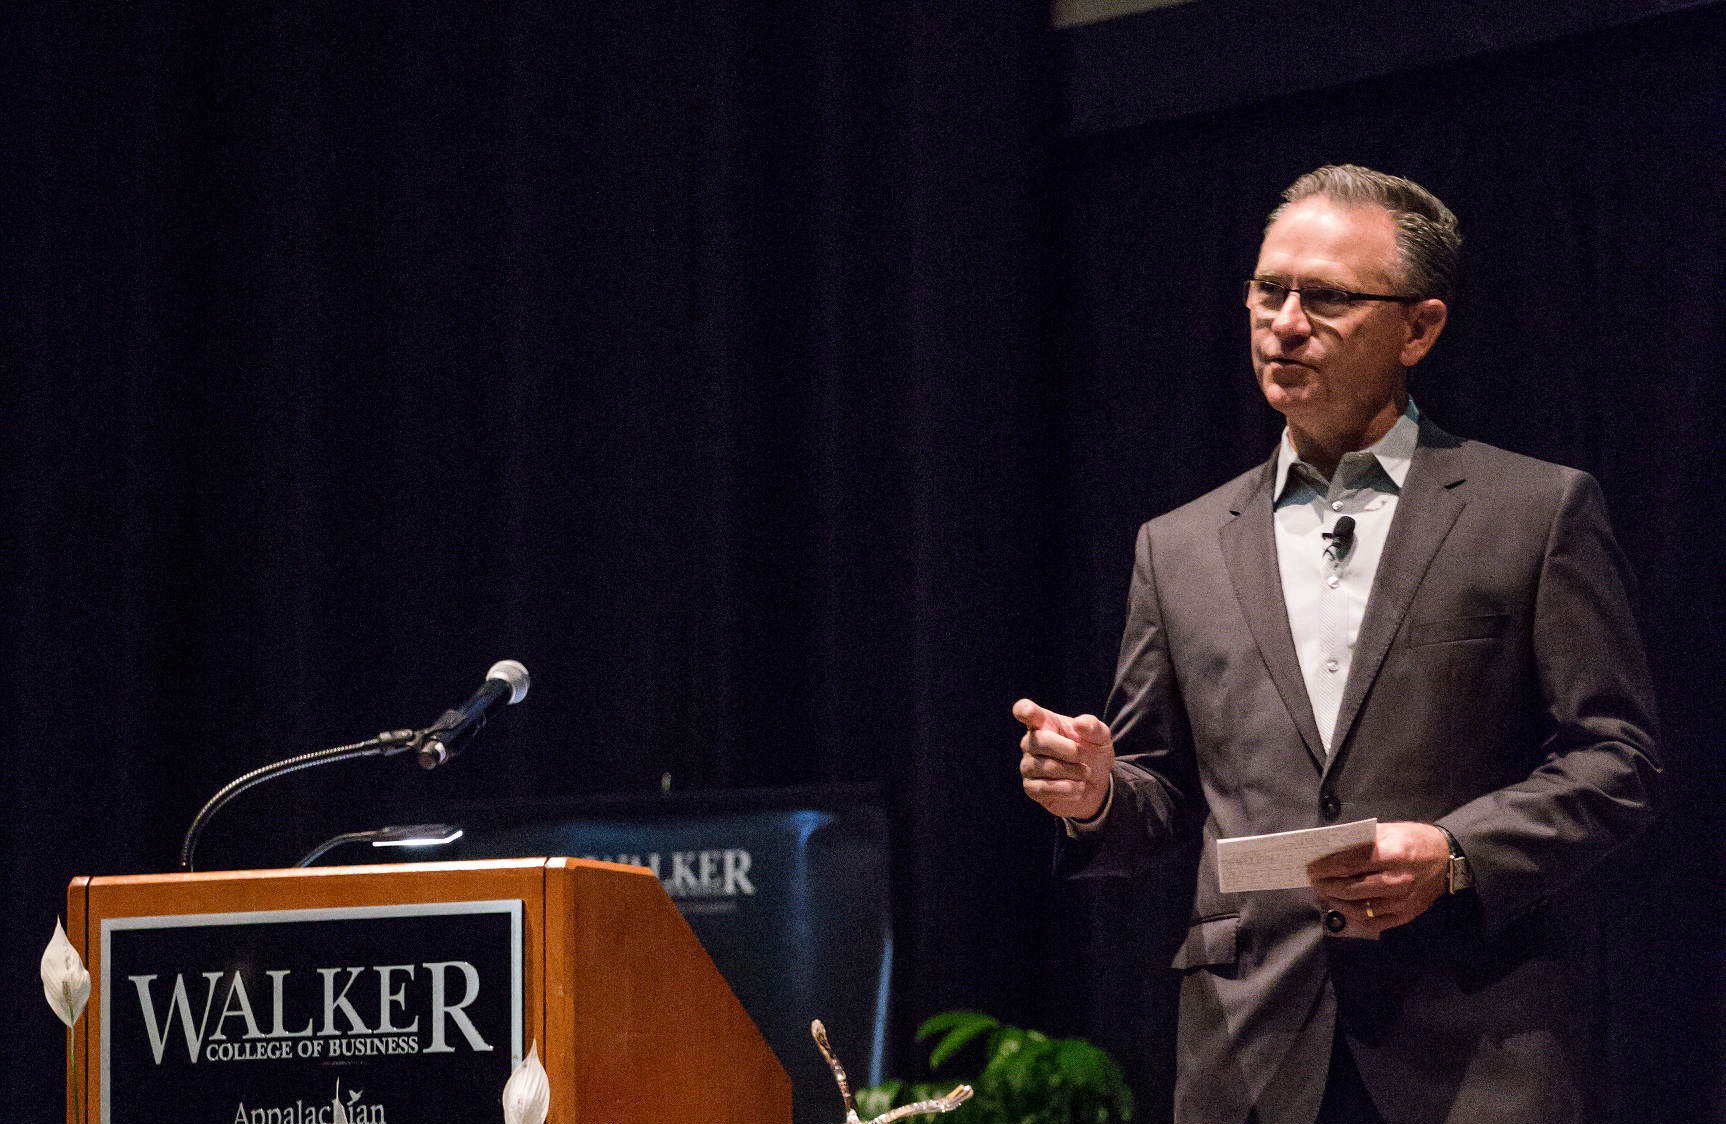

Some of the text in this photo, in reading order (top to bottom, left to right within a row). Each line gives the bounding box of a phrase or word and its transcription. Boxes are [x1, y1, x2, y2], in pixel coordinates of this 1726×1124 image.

[584, 849, 756, 896] LKER
[128, 960, 494, 1065] WALKER
[206, 1036, 419, 1061] COLLEGE OF BUSINESS
